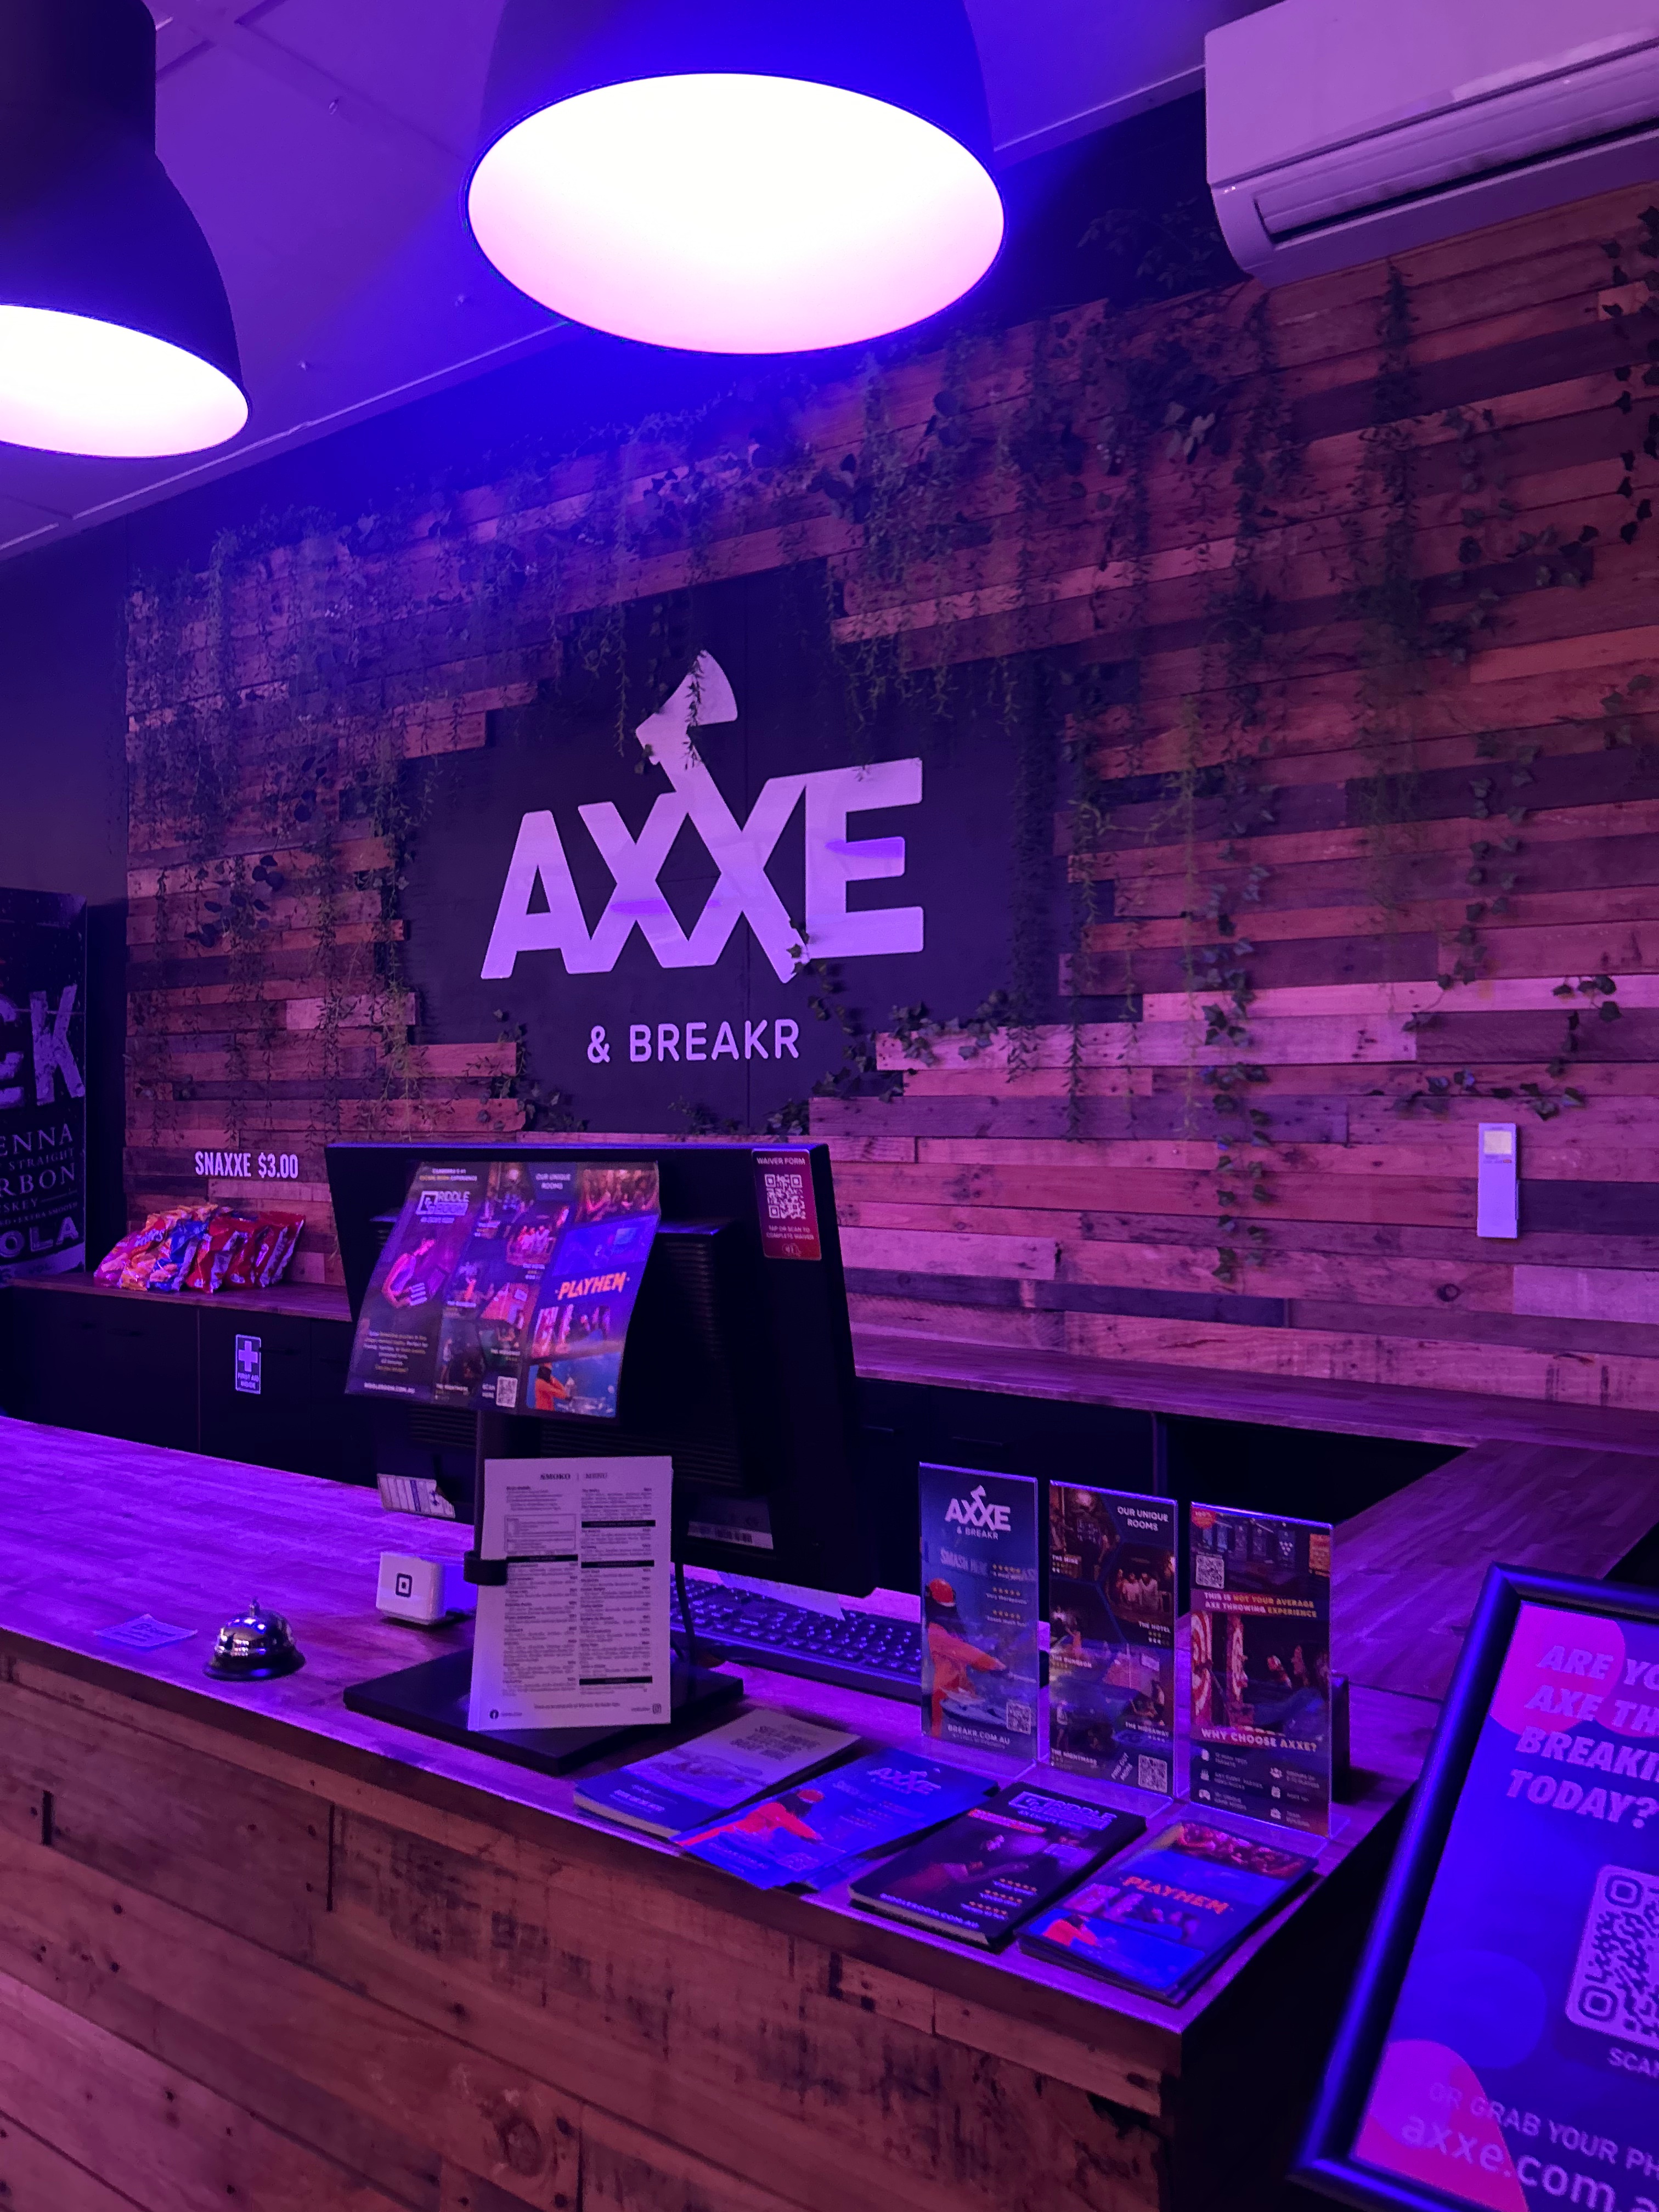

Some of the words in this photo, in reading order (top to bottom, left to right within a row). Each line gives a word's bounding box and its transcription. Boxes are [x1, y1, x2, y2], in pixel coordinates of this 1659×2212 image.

[481, 650, 923, 983] AXXE
[587, 1025, 611, 1063] &
[630, 1019, 799, 1062] BREAKR
[9, 1147, 74, 1171] STRAIGHT
[195, 1151, 251, 1177] SNAXXE
[258, 1153, 298, 1178] $3.00
[757, 1157, 783, 1165] WAIVER
[0, 1197, 38, 1214] SKEY
[0, 1216, 79, 1258] OLA
[557, 1272, 627, 1301] PLAYHEM
[945, 1485, 1011, 1532] AXXE
[1117, 1506, 1135, 1516] OUR
[1137, 1510, 1169, 1522] UNIQUE
[1127, 1519, 1159, 1532] ROOMS
[1222, 1602, 1267, 1613] THROWING
[1268, 1606, 1317, 1618] EXPERIENCE
[1537, 1645, 1615, 1680] ARE
[1523, 1684, 1605, 1722] AXE
[1201, 1728, 1227, 1741] WHY
[1231, 1732, 1277, 1747] CHOOSE
[1280, 1739, 1317, 1752] AXXE?
[1515, 1725, 1659, 1784] BREAKI
[1506, 1769, 1659, 1829] TODAY?
[1122, 1876, 1229, 1915] PLAYHEM
[1470, 2096, 1541, 2137] GRAB
[1548, 2118, 1619, 2165] YOUR
